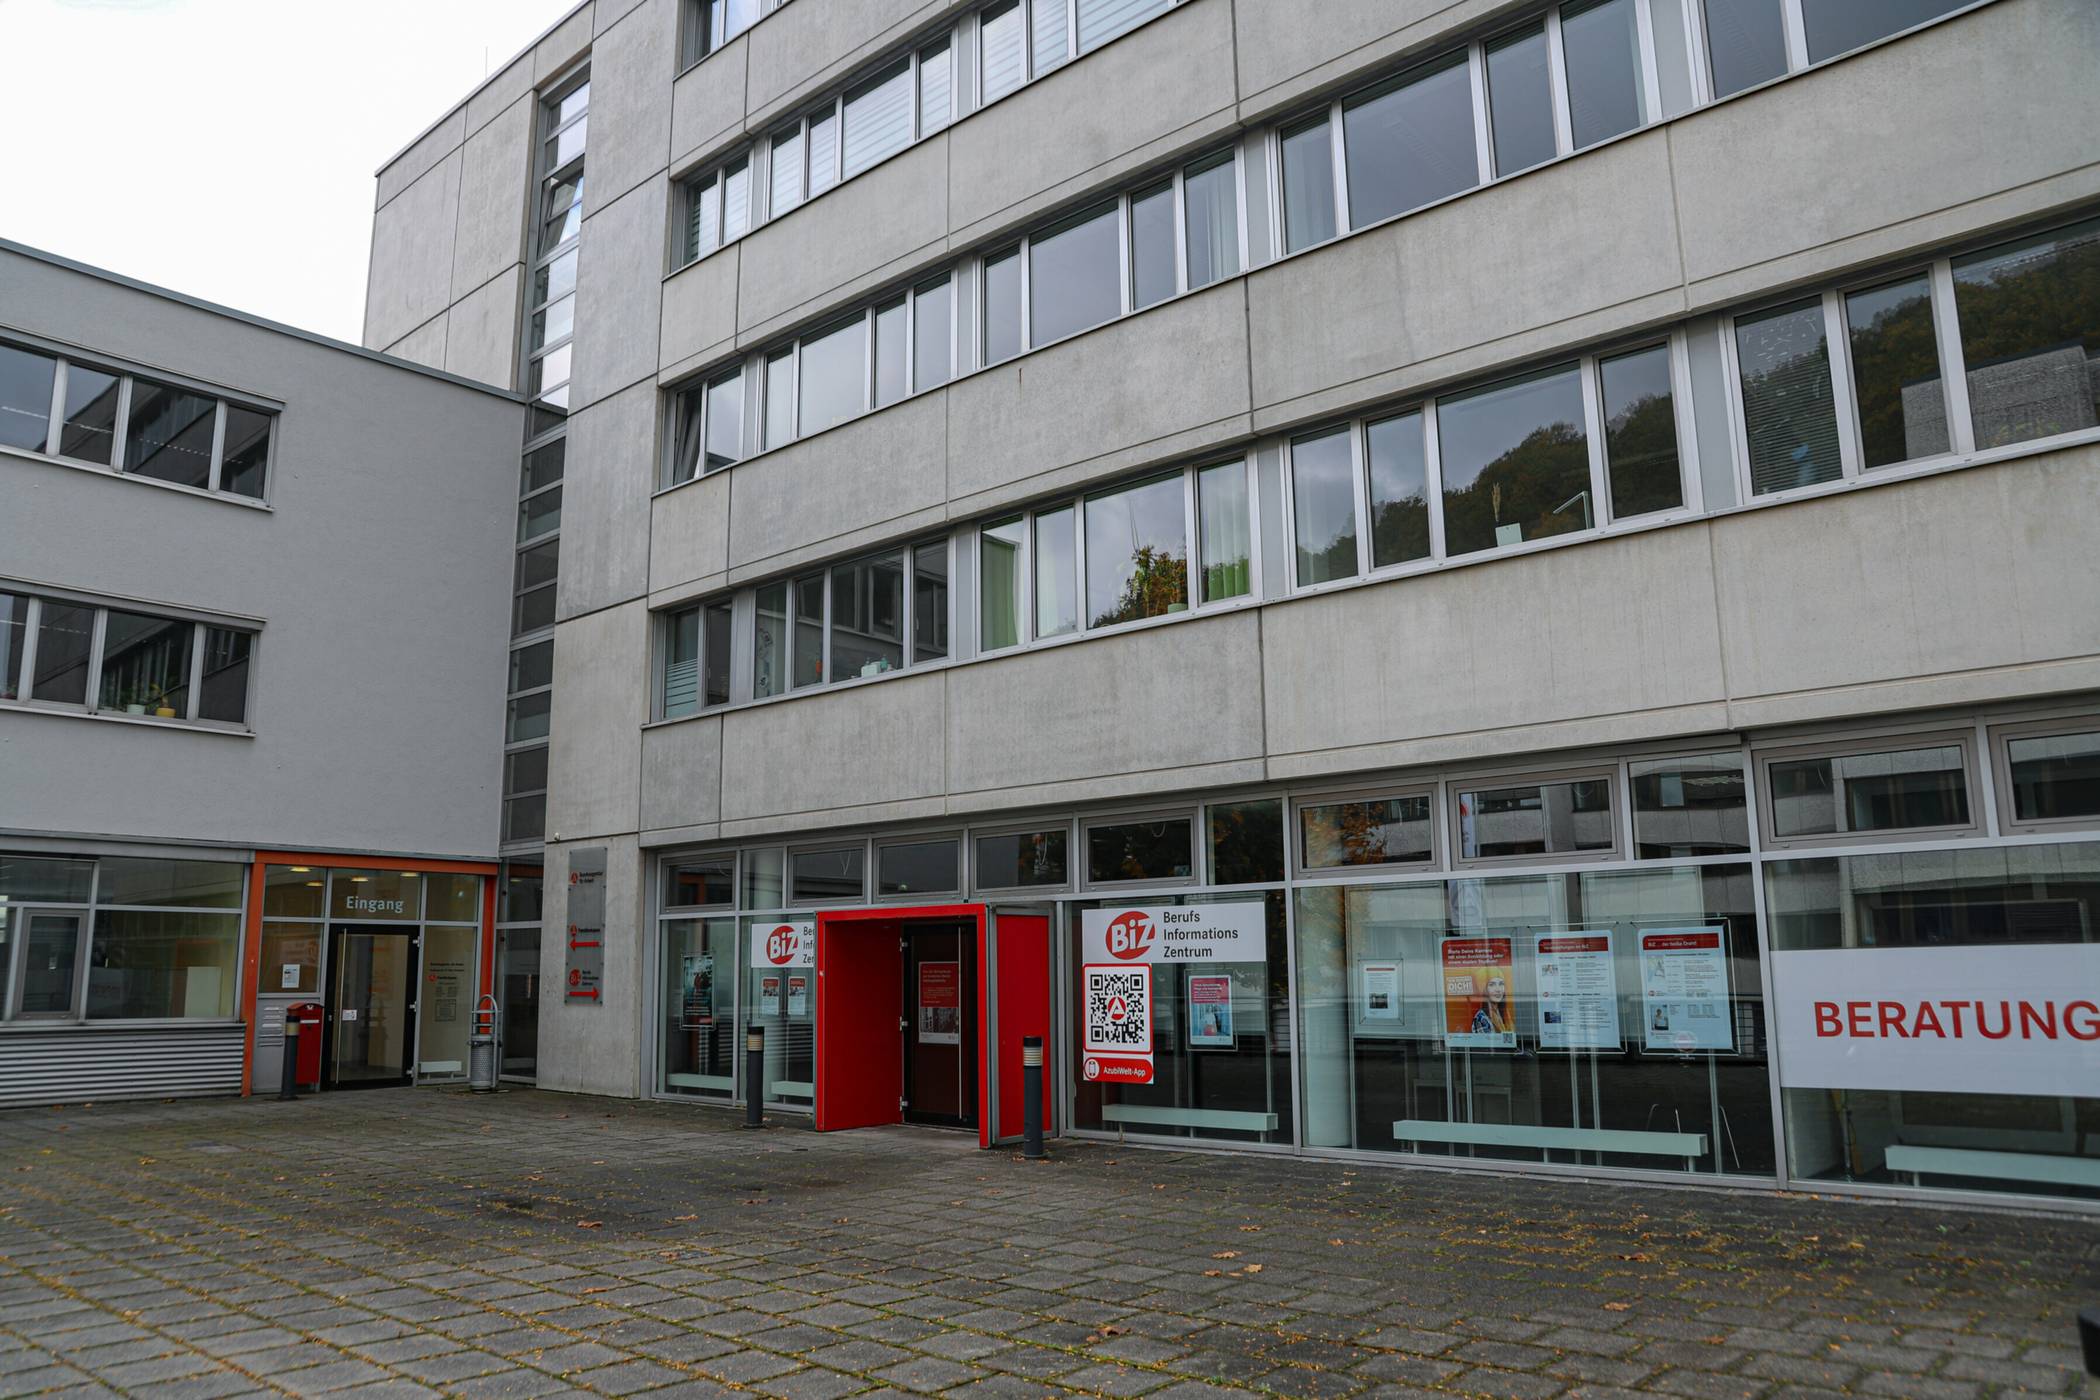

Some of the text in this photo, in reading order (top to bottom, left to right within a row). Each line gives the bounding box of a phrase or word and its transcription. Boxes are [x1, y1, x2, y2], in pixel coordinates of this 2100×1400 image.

[346, 895, 404, 914] Eingang
[1163, 910, 1201, 924] Berufs
[1110, 917, 1157, 955] BiZ
[1163, 927, 1239, 941] Informations
[769, 931, 799, 960] BiZ
[1163, 945, 1213, 958] Zentrum
[1813, 1000, 2100, 1041] BERATUNG
[1103, 1065, 1147, 1078] AzubiWelt-App
